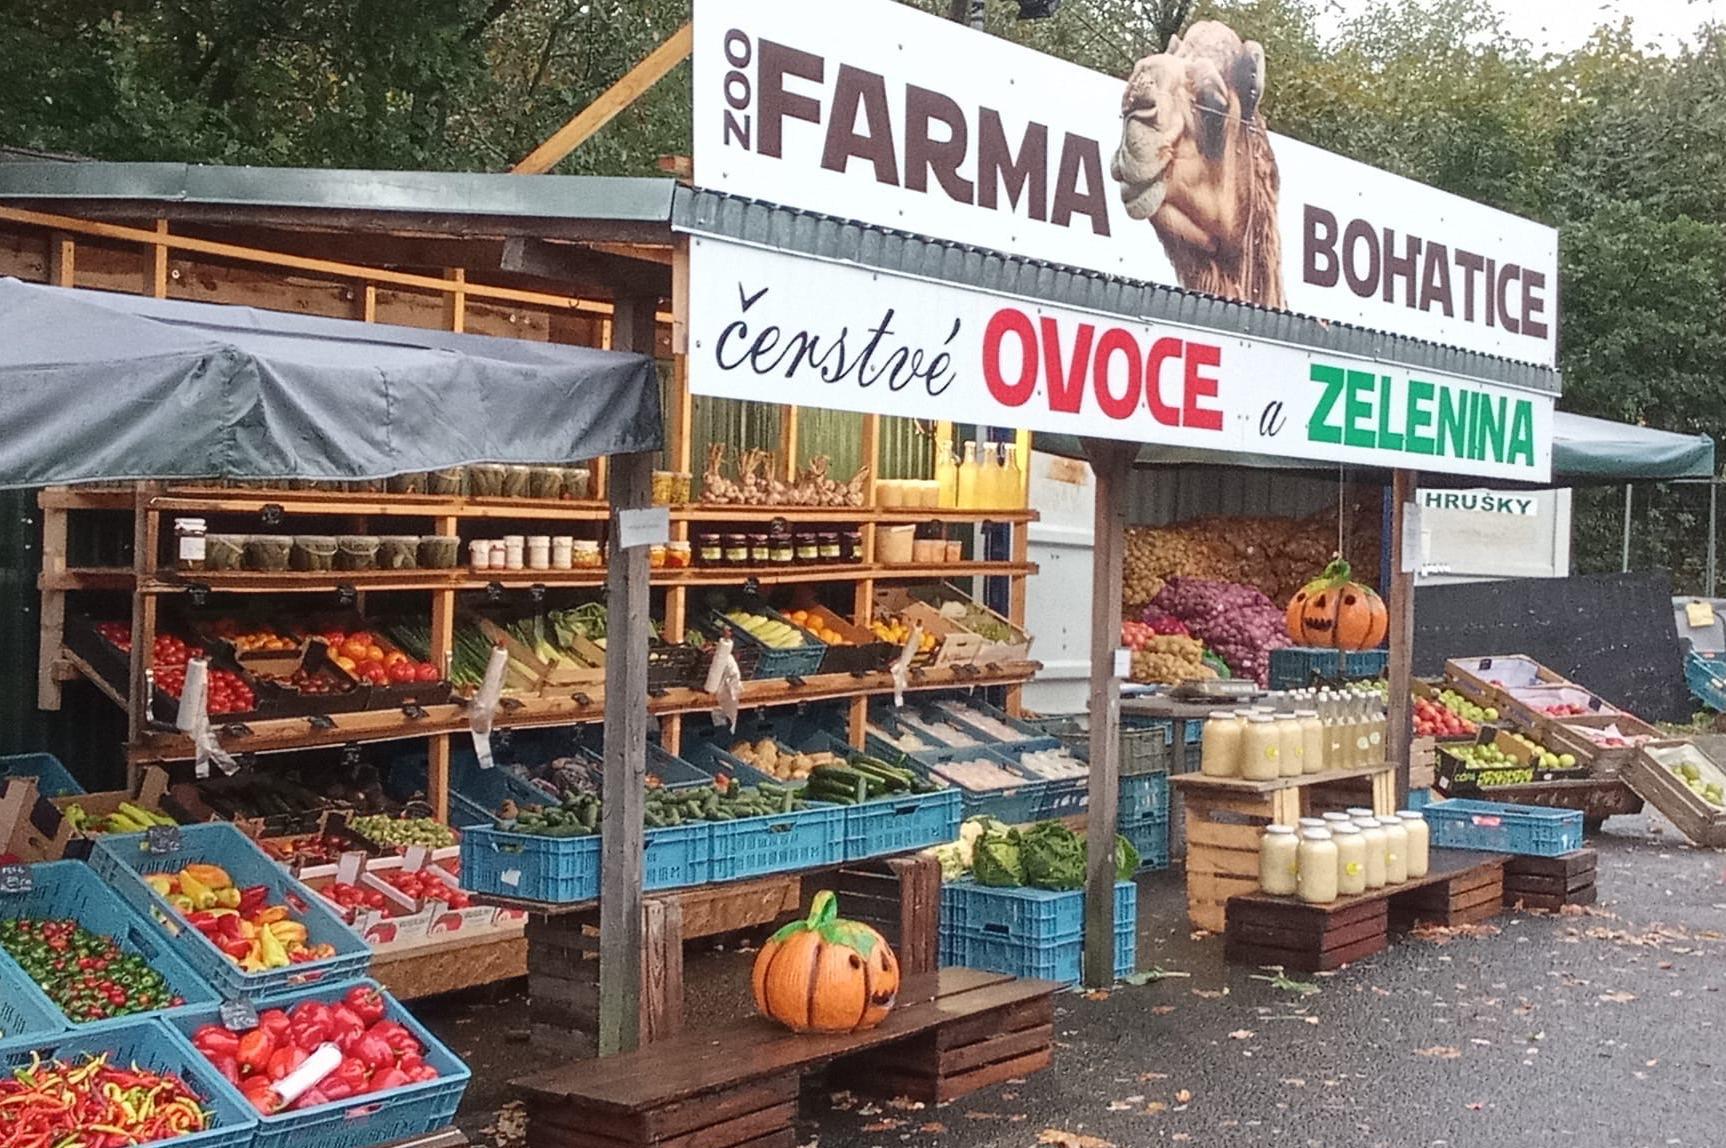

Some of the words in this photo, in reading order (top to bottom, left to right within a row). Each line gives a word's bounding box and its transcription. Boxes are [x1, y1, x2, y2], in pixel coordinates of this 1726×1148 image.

[724, 28, 752, 151] ZOO
[757, 37, 1111, 237] FARMA
[1303, 203, 1548, 340] BOHATICE
[715, 281, 961, 396] čerstvé
[983, 308, 1223, 431] OVOCE
[1259, 400, 1287, 437] a
[1308, 363, 1535, 466] ZELENINA
[1425, 492, 1532, 515] HRUŠKY
